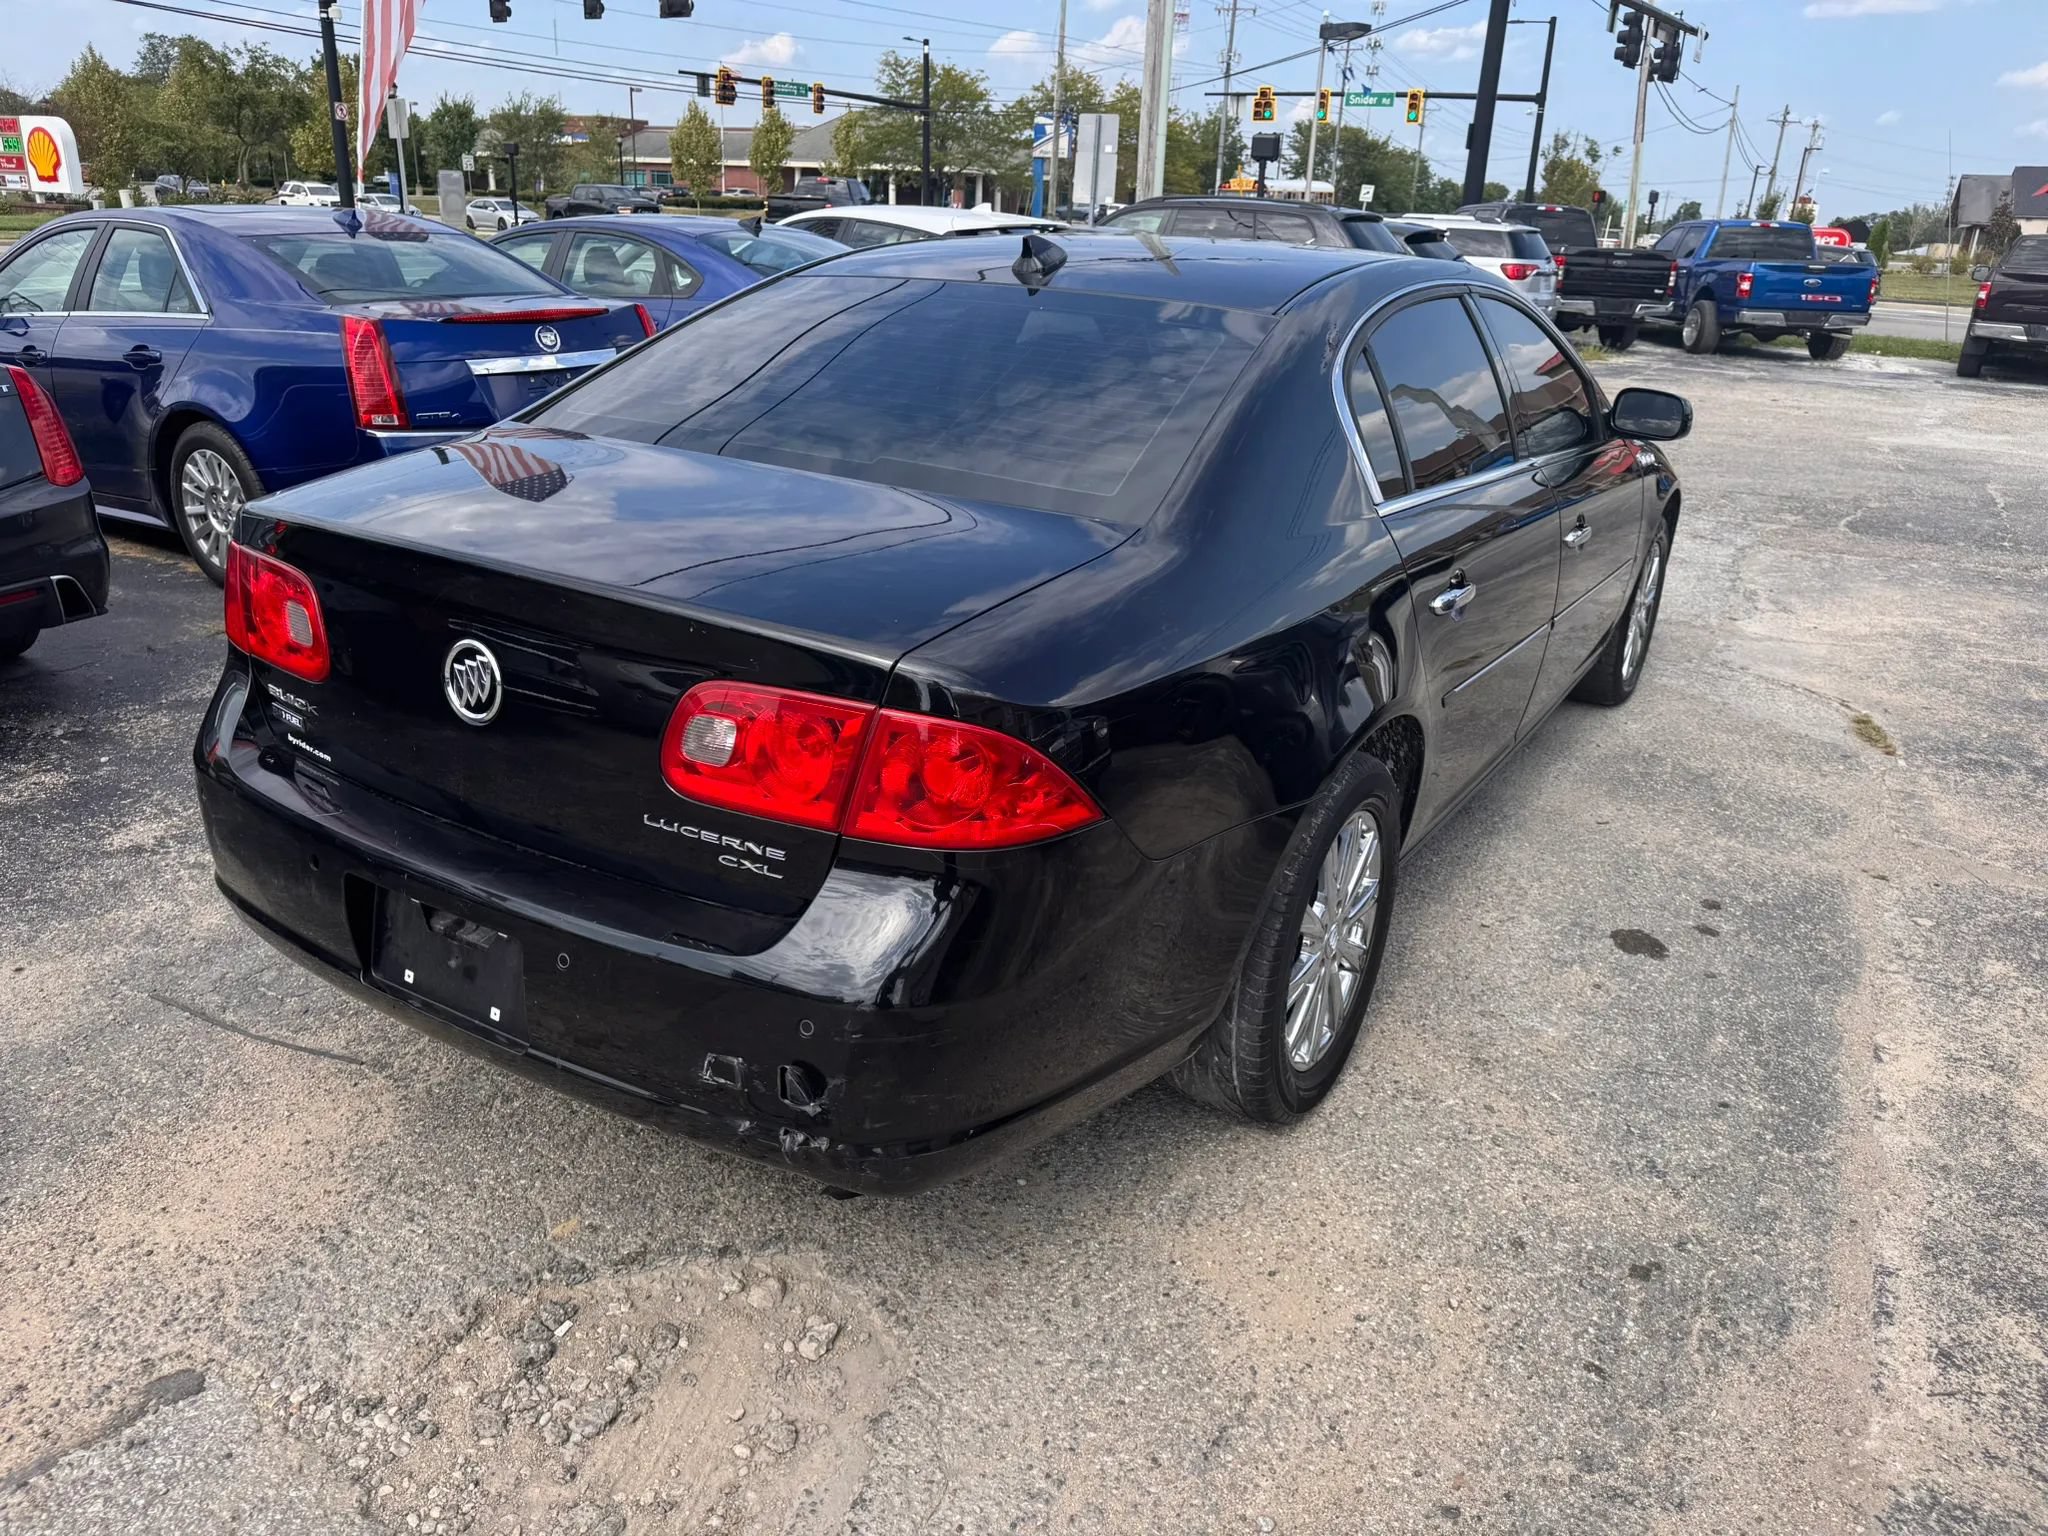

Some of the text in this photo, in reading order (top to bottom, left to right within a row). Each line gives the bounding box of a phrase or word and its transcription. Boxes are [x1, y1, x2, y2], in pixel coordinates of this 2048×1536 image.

[1349, 95, 1378, 104] Snider
[1801, 294, 1841, 302] 150
[287, 732, 331, 762] byrider.com
[643, 813, 786, 861] LUCERNE
[718, 854, 784, 879] CXL
